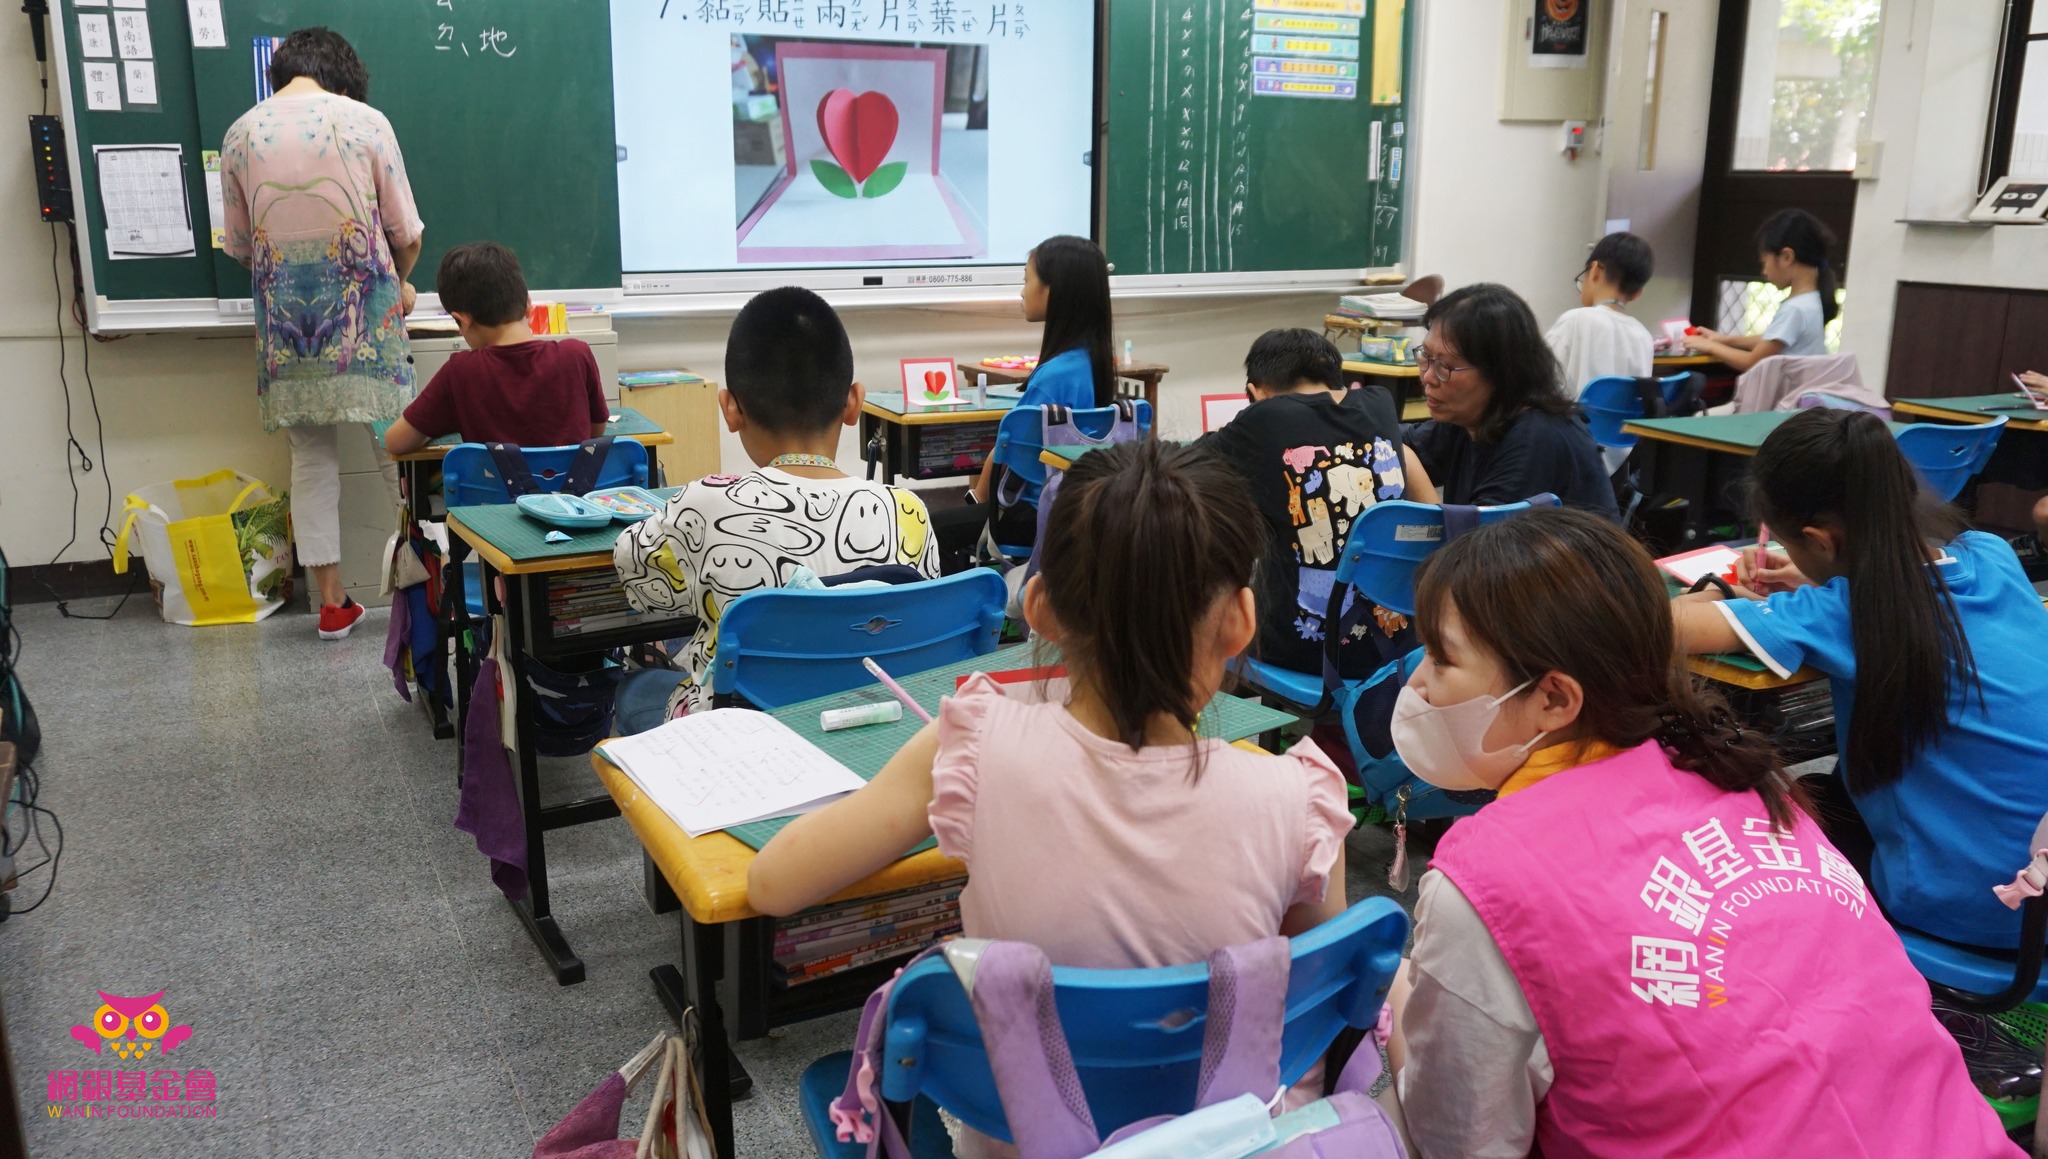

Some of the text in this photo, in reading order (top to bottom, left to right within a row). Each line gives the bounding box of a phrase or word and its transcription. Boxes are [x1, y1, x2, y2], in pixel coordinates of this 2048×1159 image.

[479, 26, 518, 58] 地
[1704, 875, 1865, 1009] WANIN FOUNDATION
